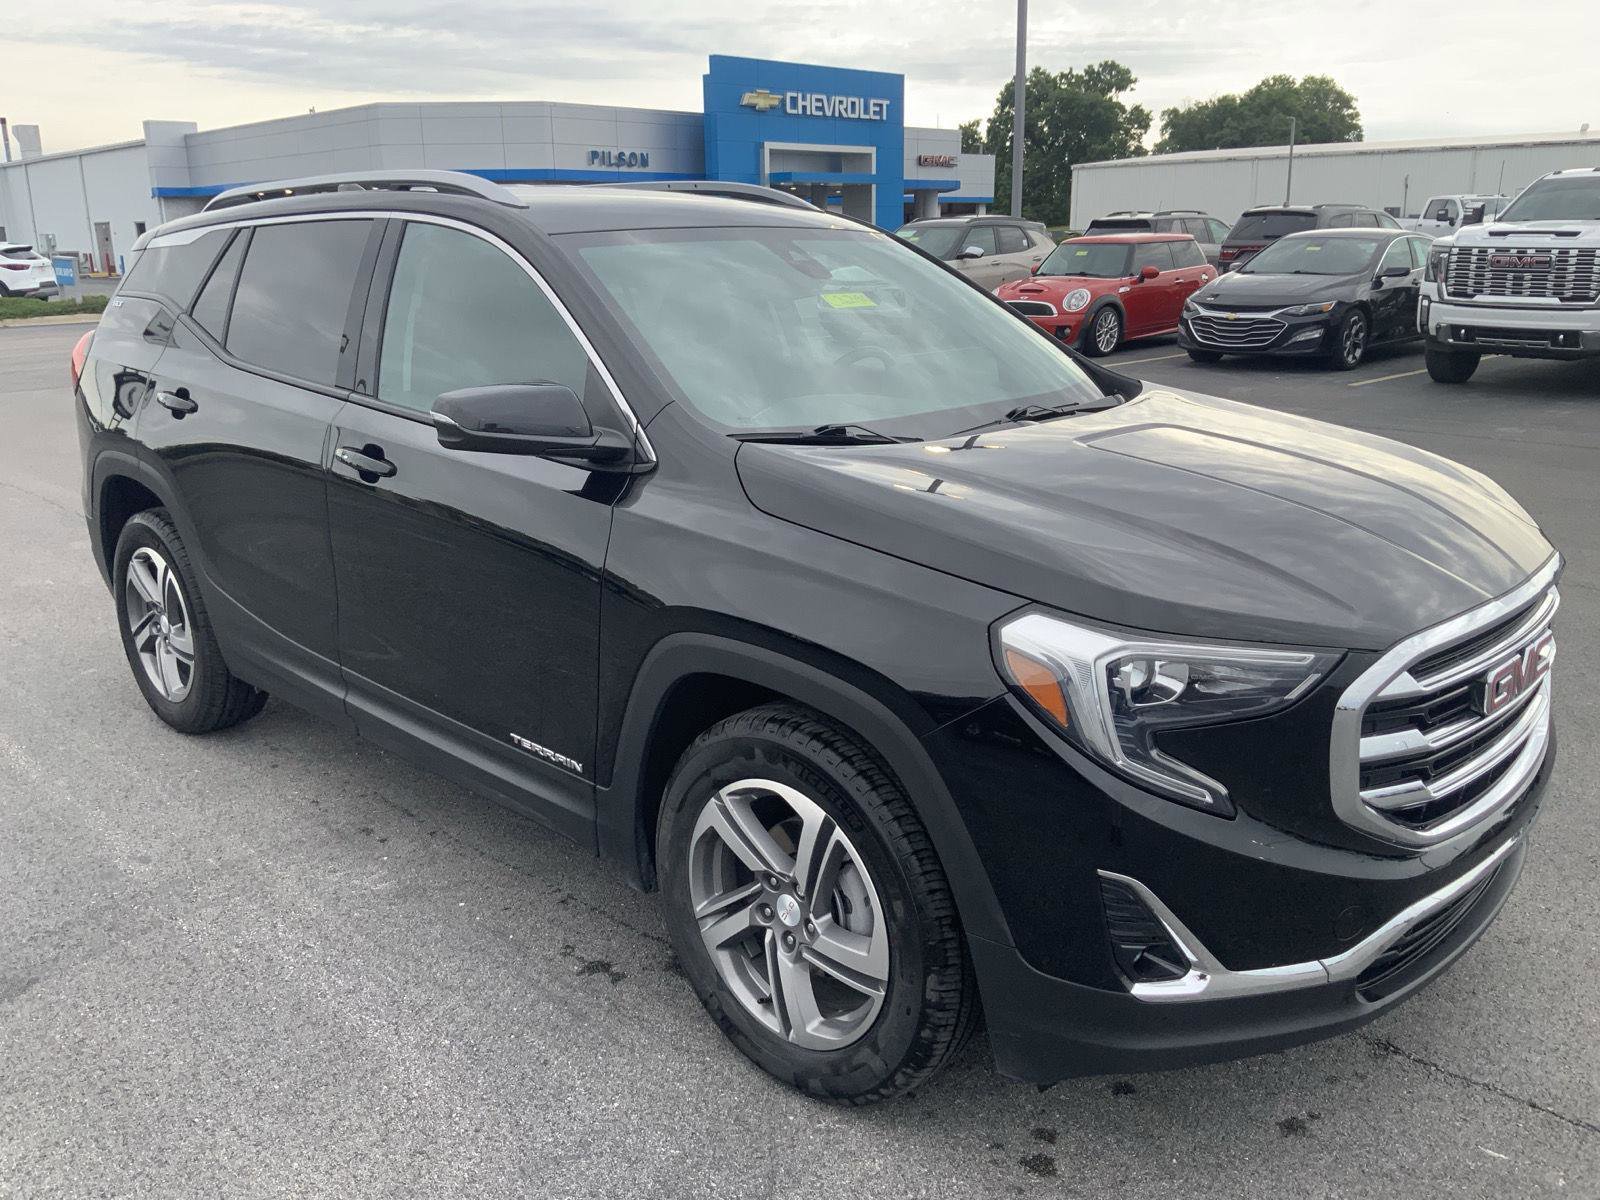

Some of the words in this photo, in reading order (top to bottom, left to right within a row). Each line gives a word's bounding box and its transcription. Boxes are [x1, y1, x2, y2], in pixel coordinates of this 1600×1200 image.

[786, 91, 890, 120] CHEVROLET
[589, 150, 649, 168] PILSON
[919, 154, 958, 168] GMC
[1492, 256, 1550, 269] GMC
[1485, 630, 1553, 715] GMC
[509, 732, 583, 774] TERRAIN
